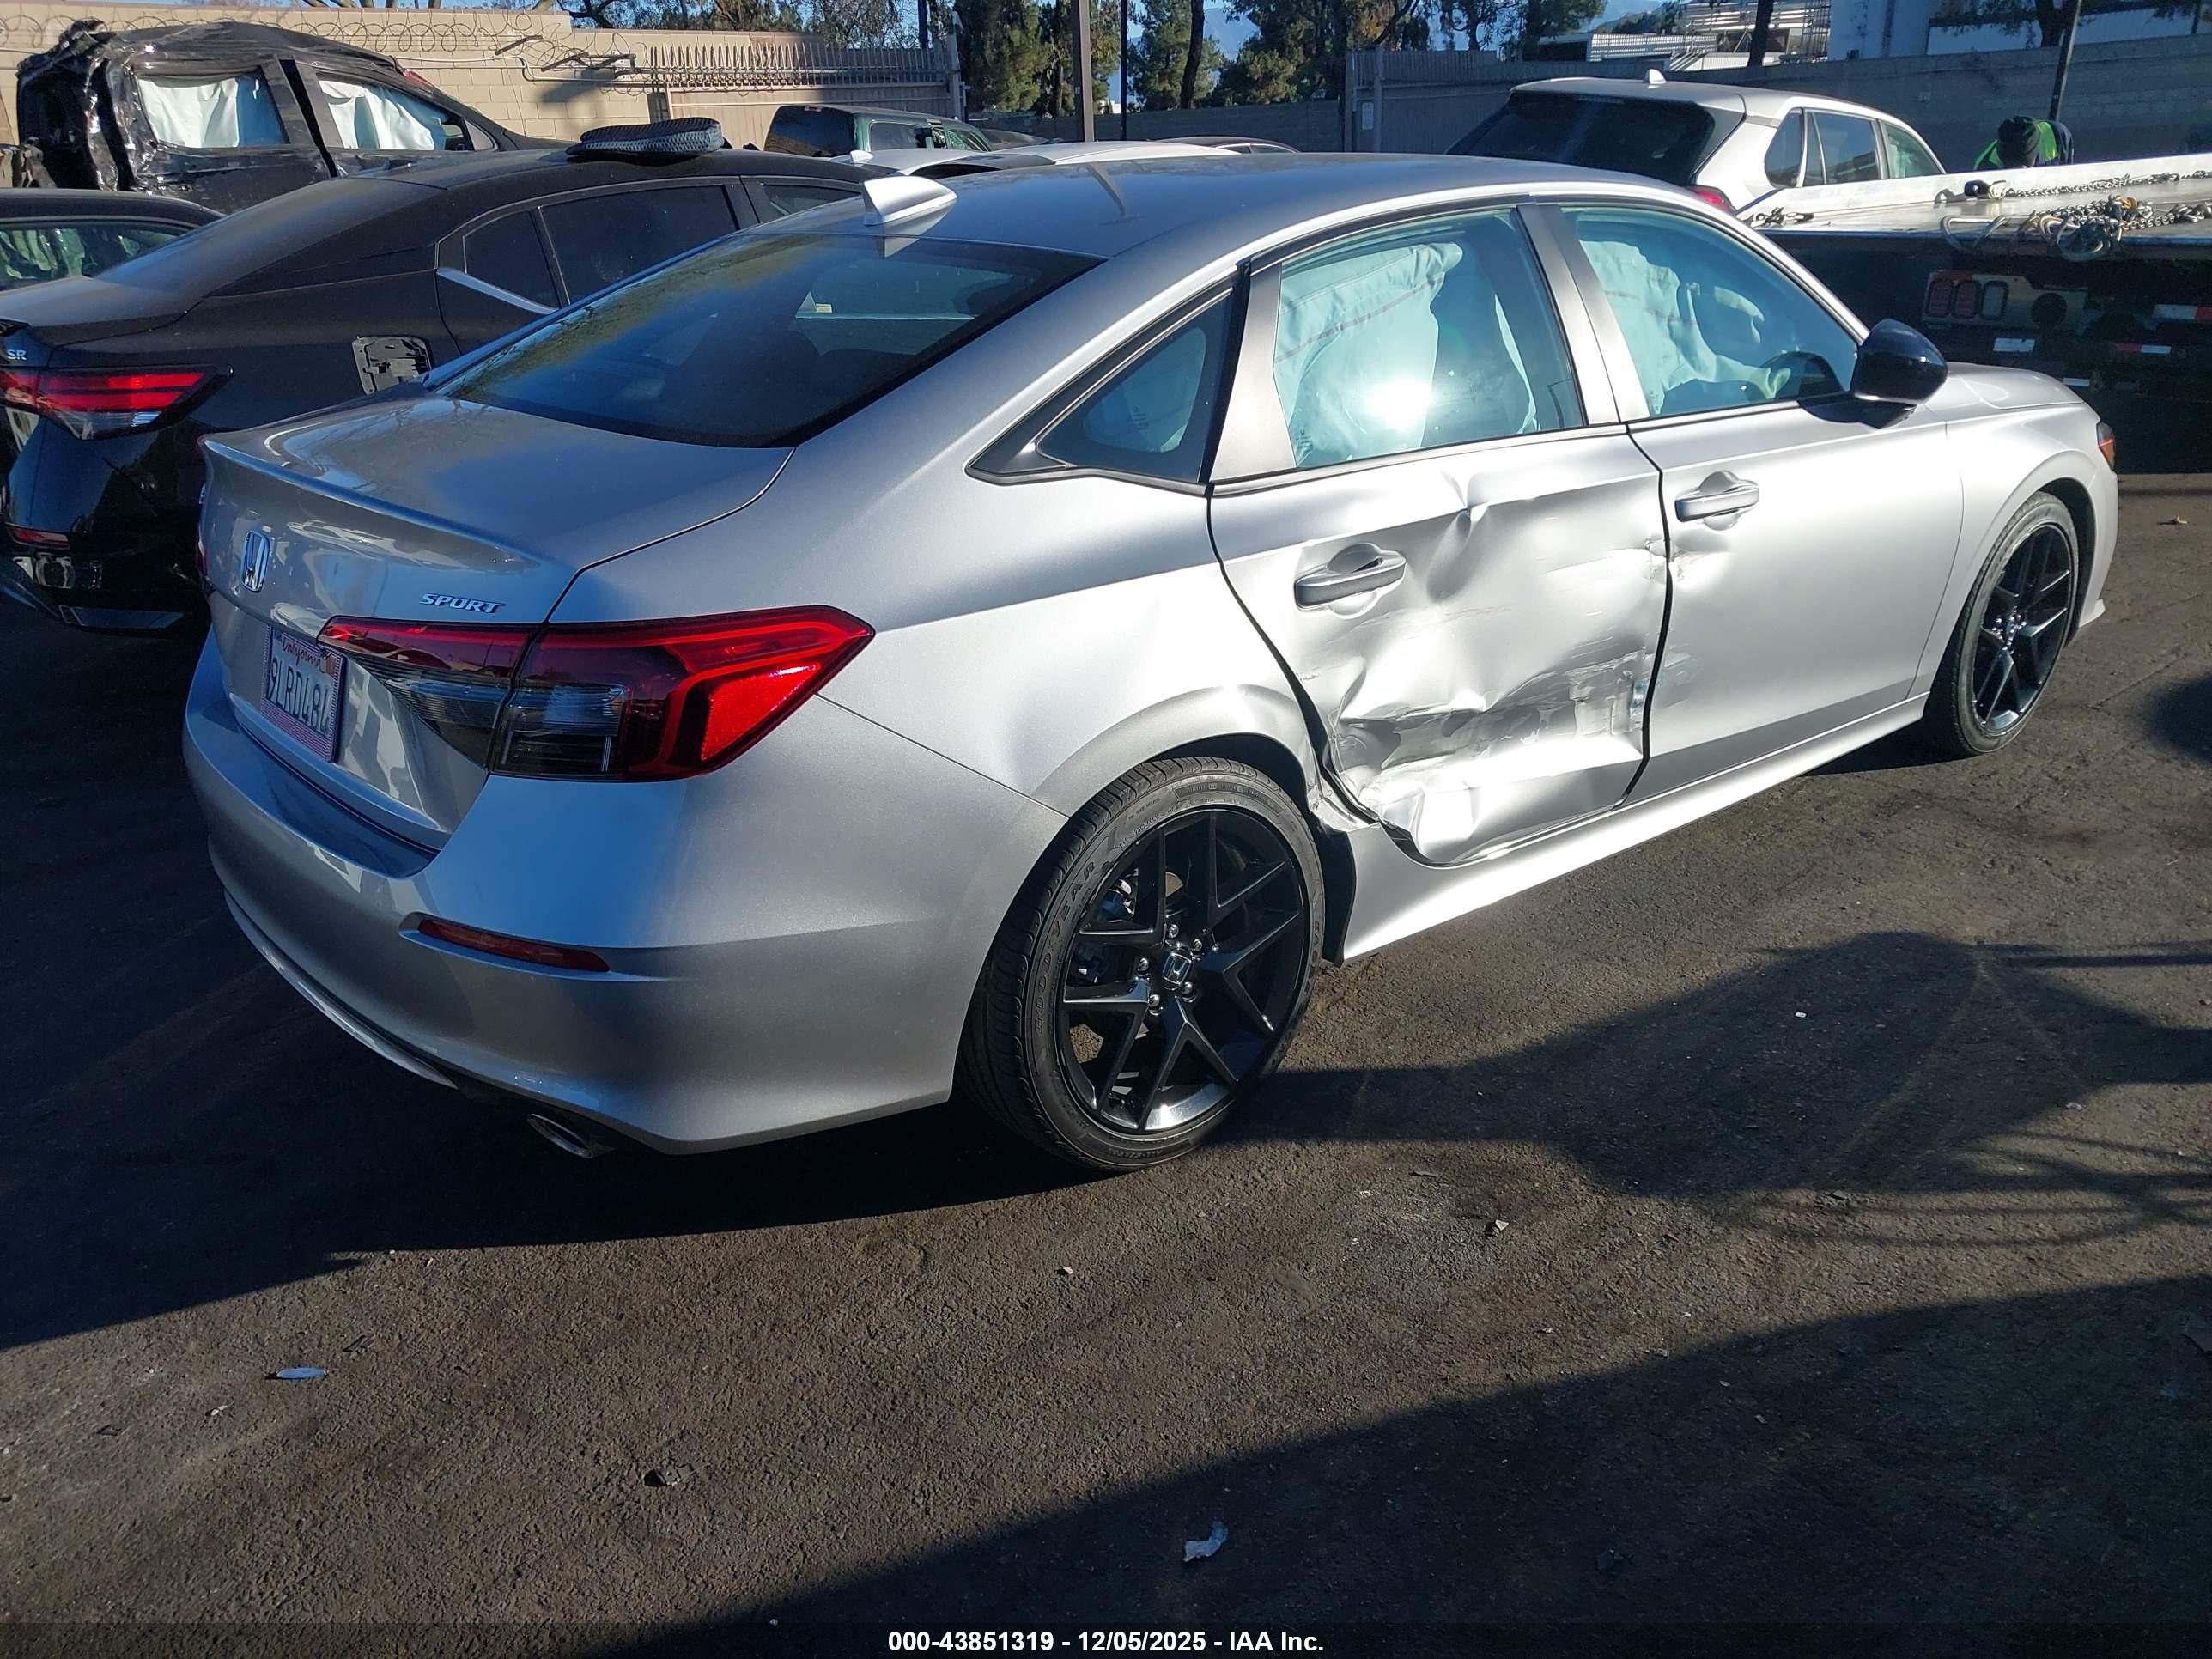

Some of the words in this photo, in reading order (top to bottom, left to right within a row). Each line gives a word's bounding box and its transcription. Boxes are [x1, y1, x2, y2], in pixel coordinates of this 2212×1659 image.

[7, 349, 27, 361] SR
[419, 593, 501, 614] SPORT
[266, 657, 331, 733] 9LRD484
